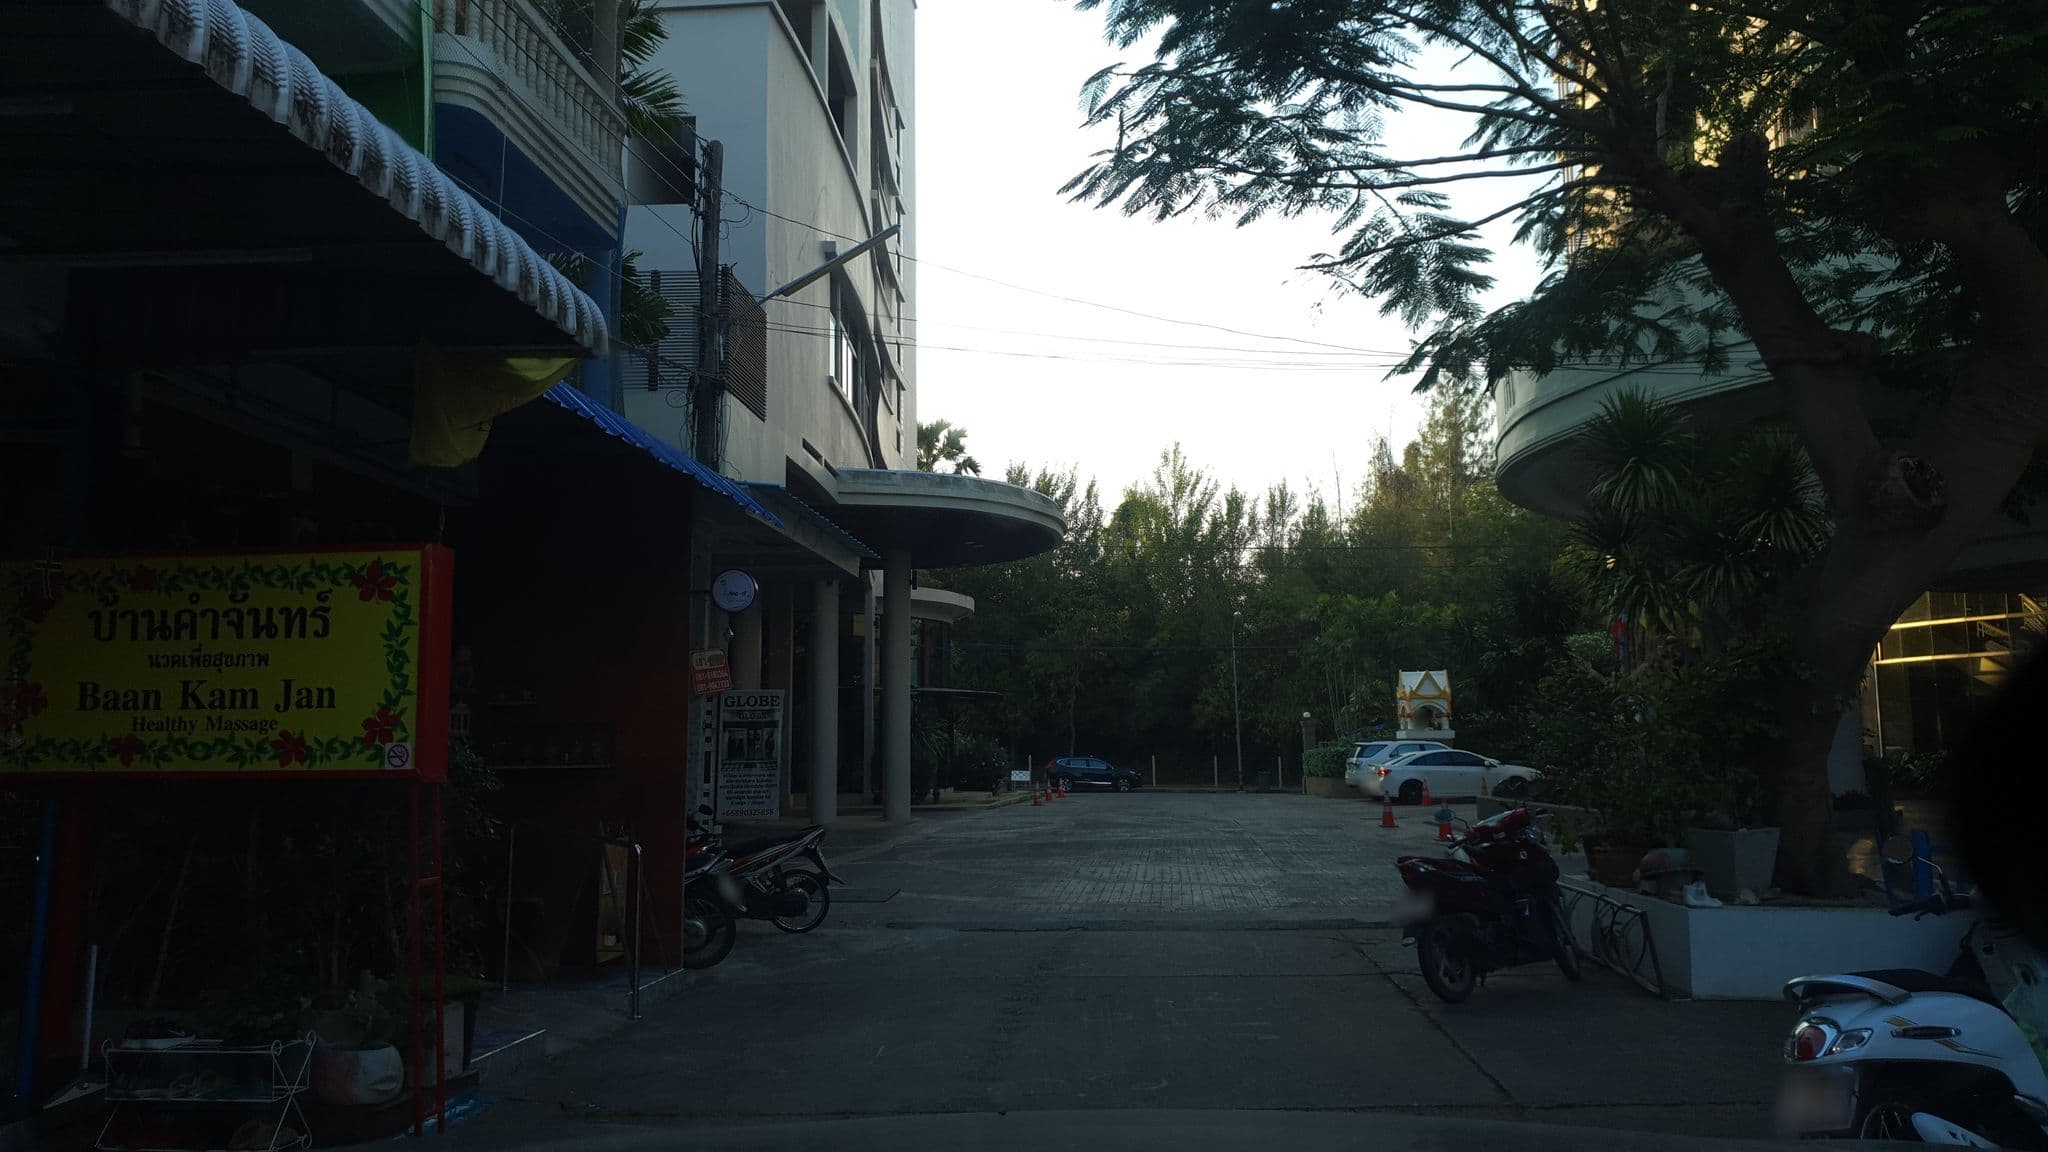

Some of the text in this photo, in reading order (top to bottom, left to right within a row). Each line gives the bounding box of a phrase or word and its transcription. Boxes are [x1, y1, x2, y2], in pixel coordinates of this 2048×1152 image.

[88, 590, 333, 641] บ้านคำจันทร์
[148, 644, 270, 673] นวดเพื่อสุขภาพ
[78, 679, 337, 713] Baan Kam Jan
[724, 695, 781, 708] GLOBE
[132, 715, 278, 734] Healthy Massage
